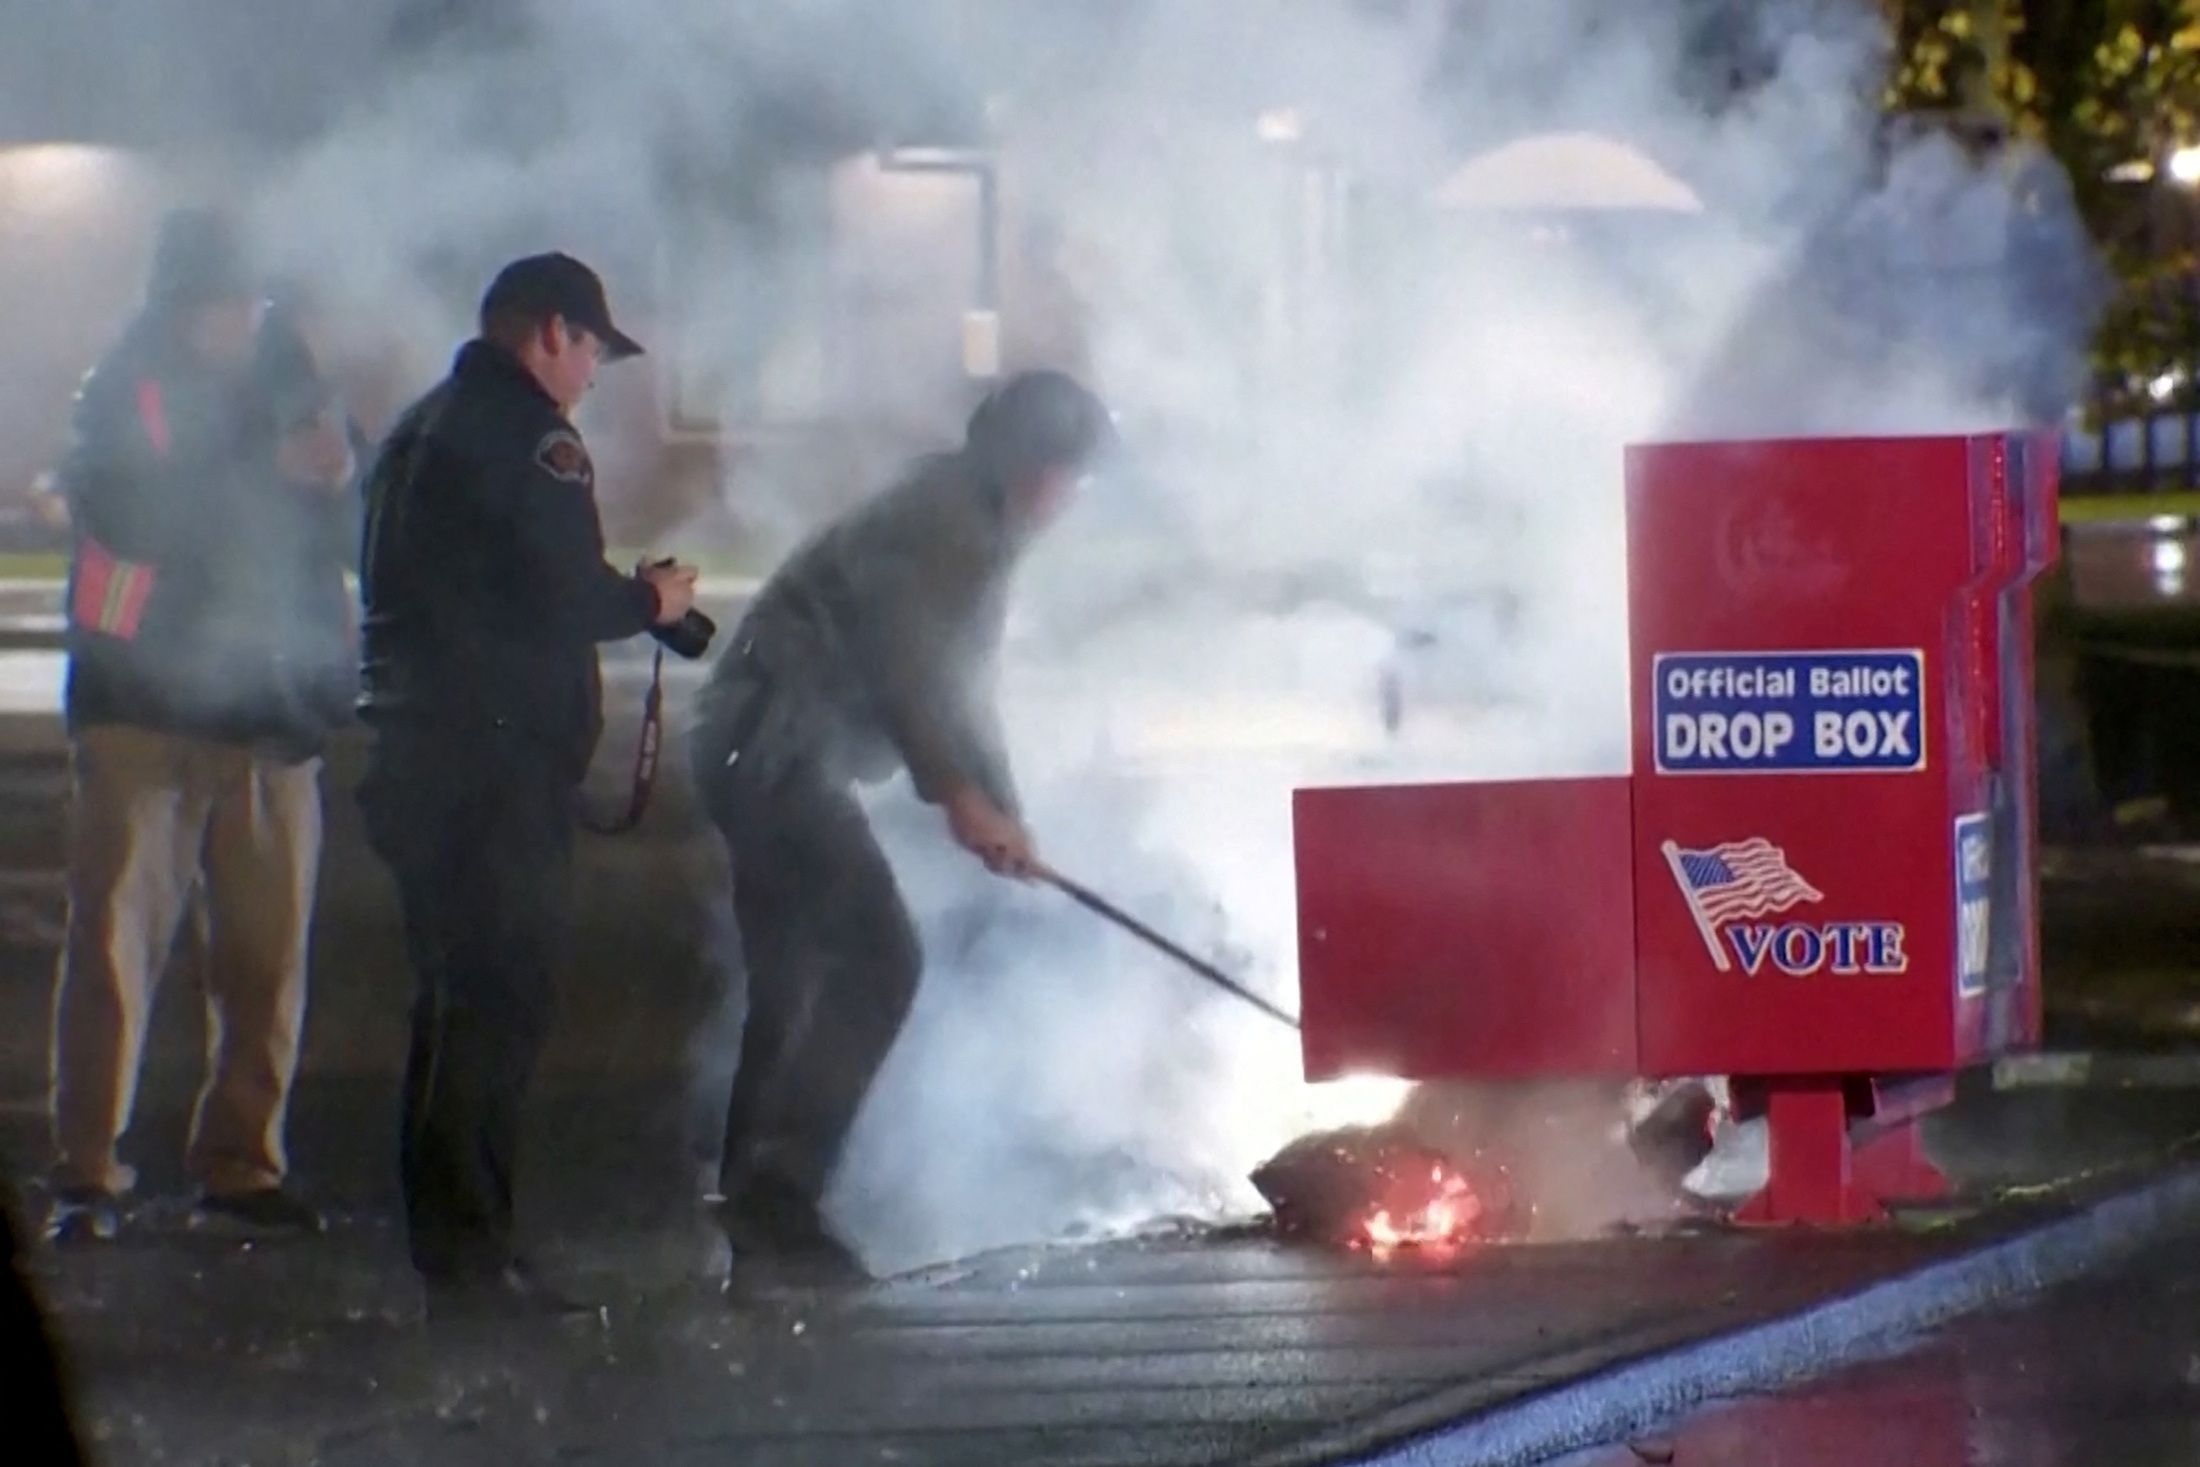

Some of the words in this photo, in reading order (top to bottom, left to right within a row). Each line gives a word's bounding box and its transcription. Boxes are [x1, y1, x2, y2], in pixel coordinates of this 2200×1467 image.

[1667, 666, 1796, 699] Official
[1809, 664, 1910, 698] Ballot
[1665, 711, 1794, 759] DROP
[1814, 710, 1912, 757] BOX
[1727, 922, 1908, 976] VOTE
